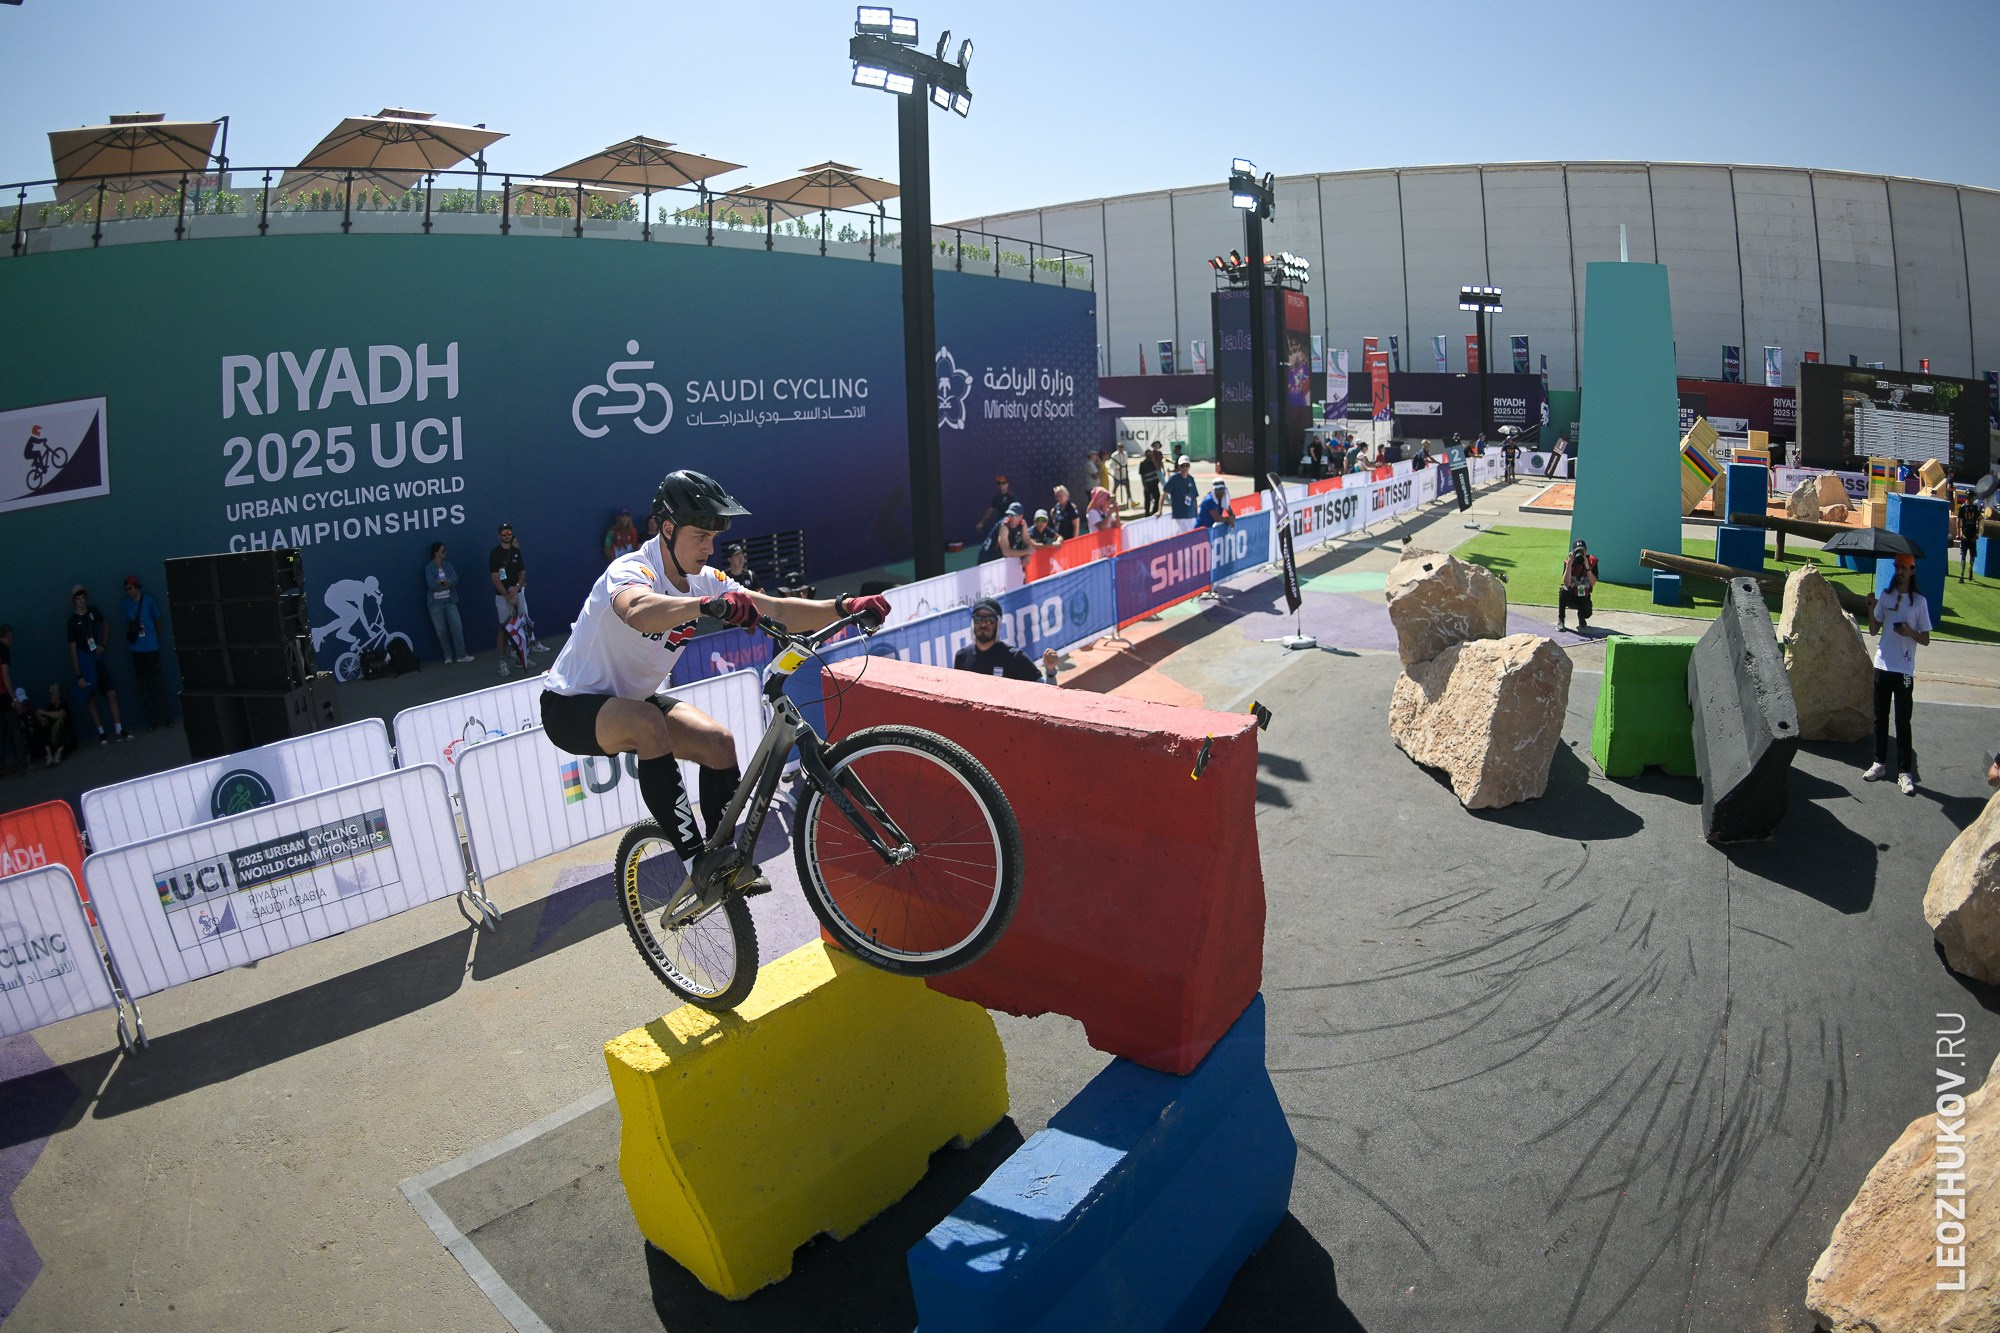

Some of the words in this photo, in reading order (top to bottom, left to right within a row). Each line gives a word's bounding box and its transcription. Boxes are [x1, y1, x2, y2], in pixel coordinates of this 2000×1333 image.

[222, 341, 460, 419] RIYADH
[686, 379, 764, 403] SAUDI
[773, 378, 868, 400] CYCLING
[983, 367, 1036, 396] الرياضة
[1041, 368, 1074, 396] وزارة
[984, 400, 1028, 422] Ministry
[1030, 400, 1043, 418] of
[1044, 400, 1075, 421] Sport
[1493, 397, 1526, 407] RIYADH
[1493, 407, 1511, 415] 2025
[1126, 430, 1149, 441] UCI
[223, 424, 357, 488] 2025
[370, 416, 464, 469] UCI
[1450, 448, 1462, 461] 2
[226, 496, 299, 522] URBAN
[302, 483, 390, 511] CYCLING
[393, 475, 466, 500] WORLD
[1385, 480, 1412, 506] TISSOT
[1314, 494, 1358, 530] TISSOT
[229, 504, 467, 554] CHAMPIONSHIPS
[892, 737, 912, 745] THE
[913, 741, 963, 771] NATIONAL
[236, 852, 263, 868] 2025
[266, 840, 305, 860] URBAN
[307, 824, 359, 848] CYCLING
[239, 861, 285, 883] WORLD
[286, 831, 384, 868] CHAMPIONSHIPS
[169, 862, 230, 901] UCI
[248, 884, 288, 905] RIYADH
[252, 900, 286, 919] SAUDI
[288, 888, 327, 909] ARABIA
